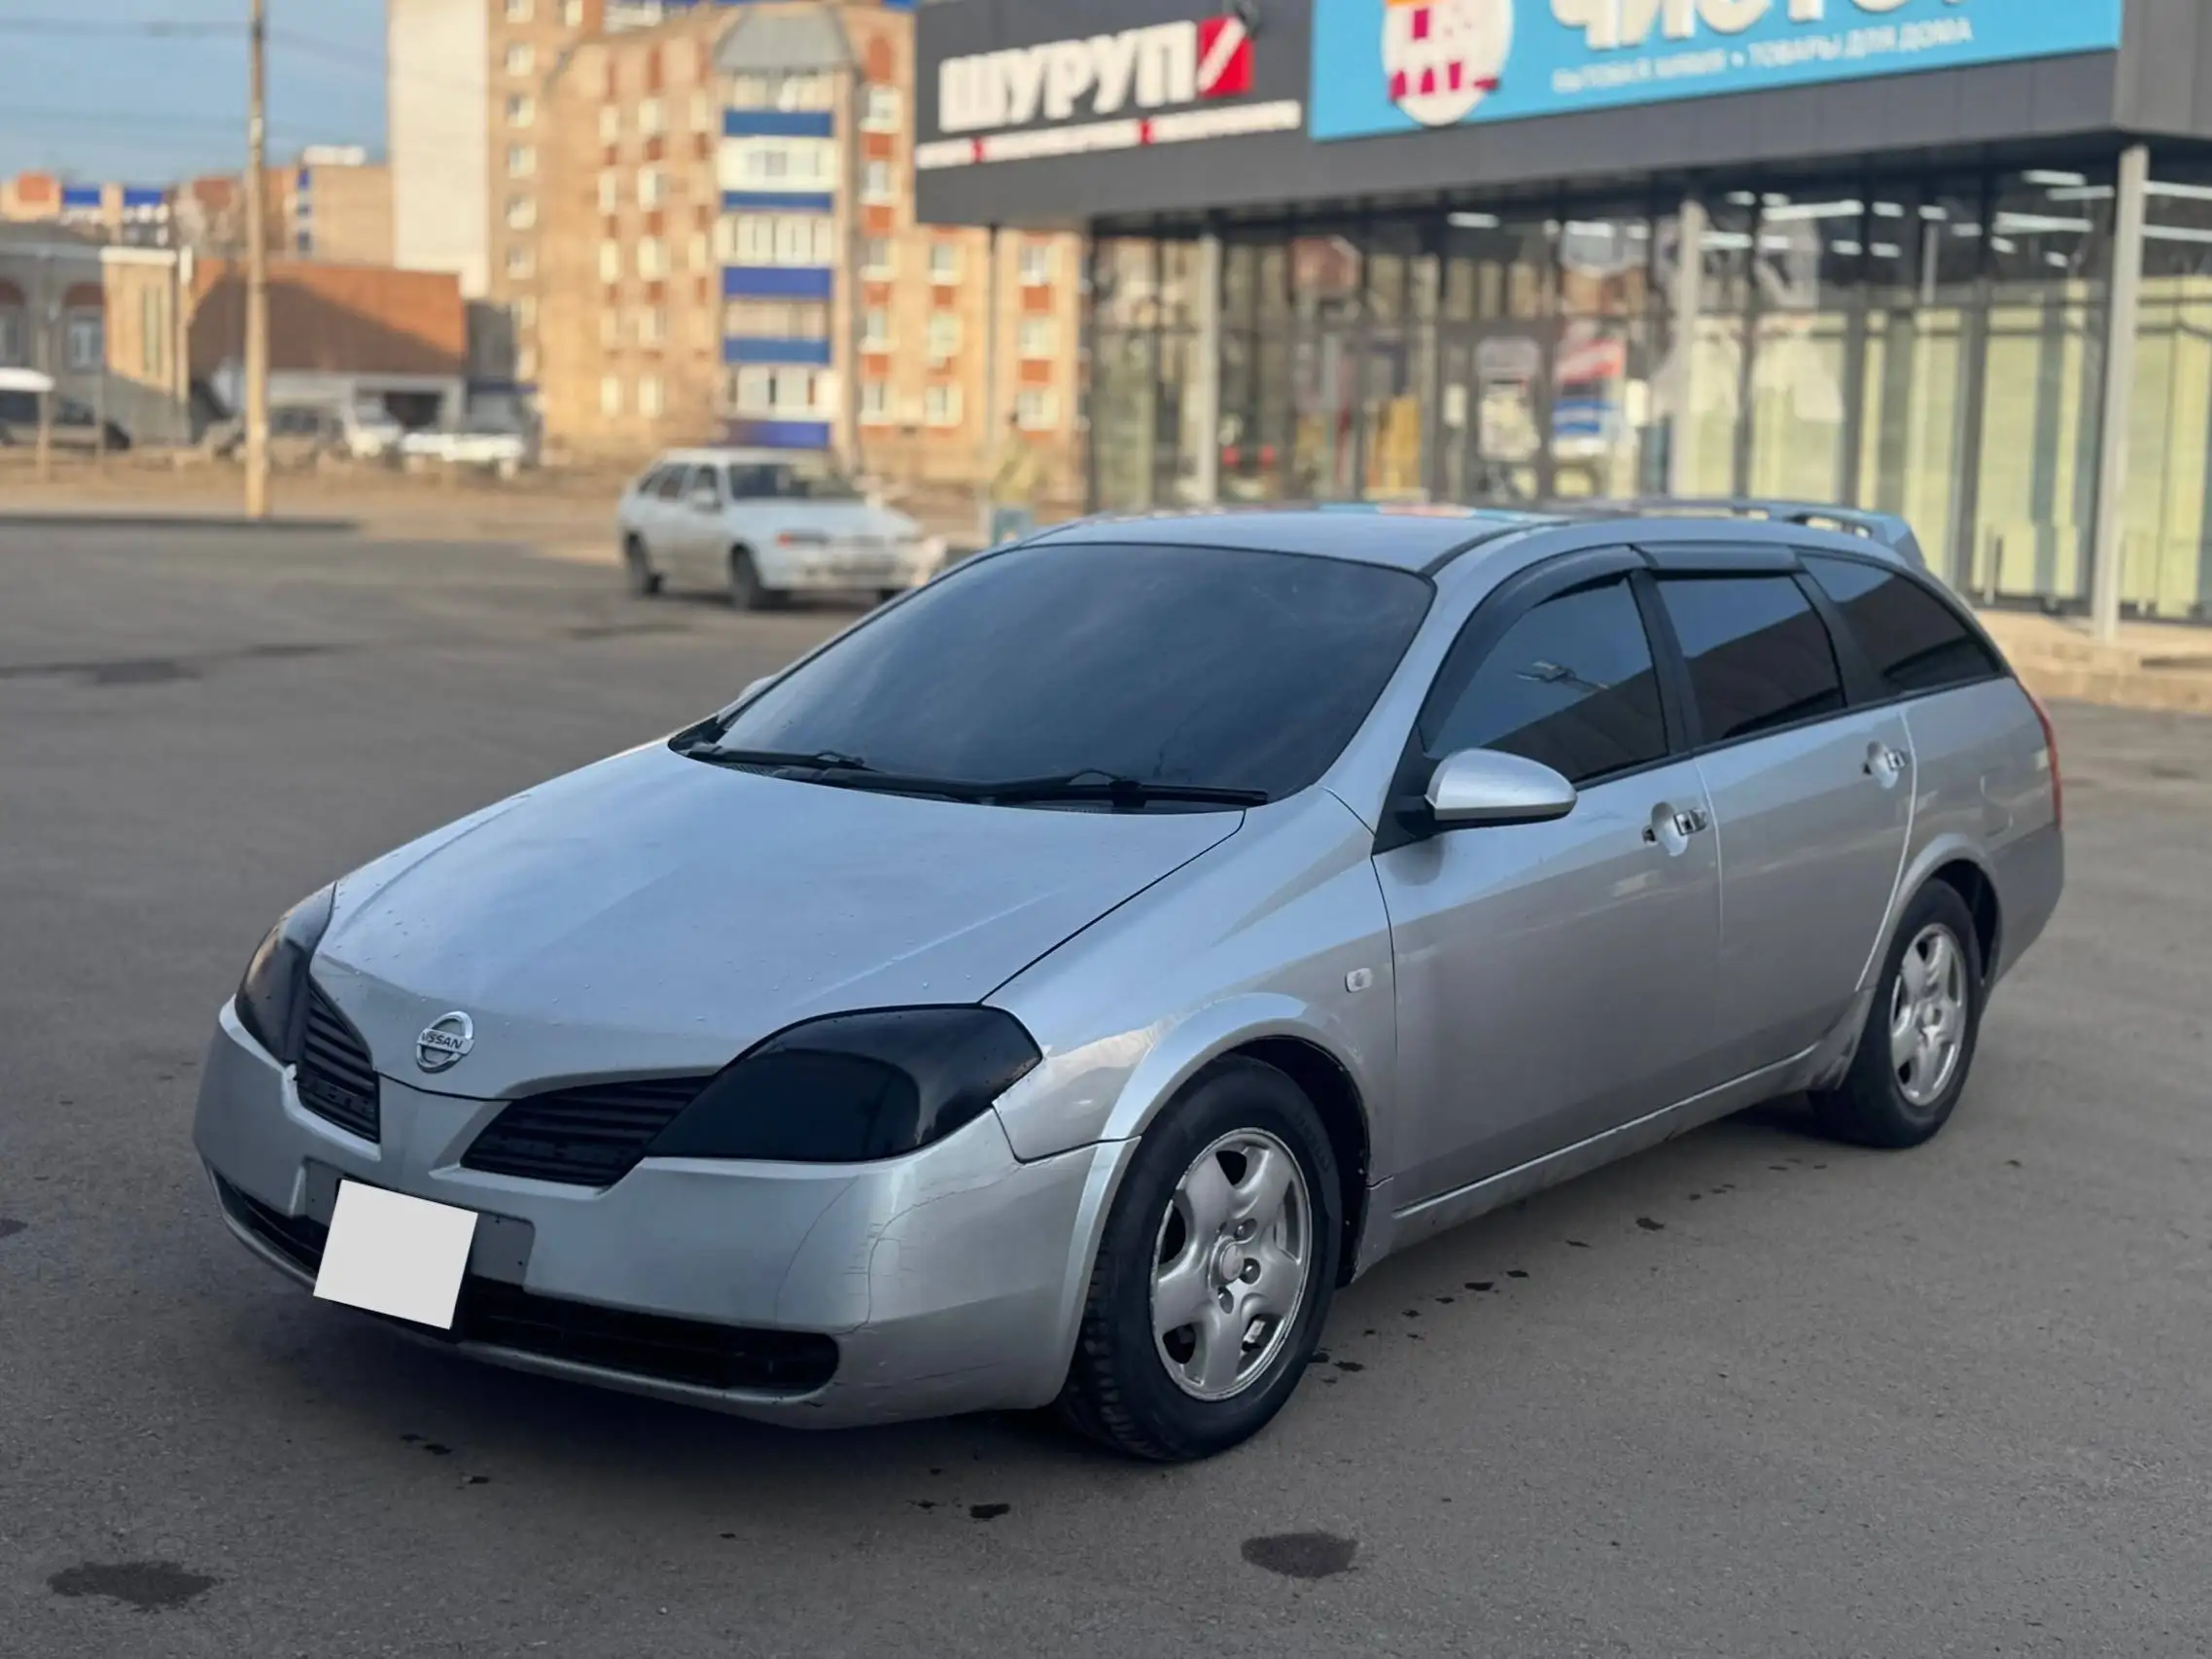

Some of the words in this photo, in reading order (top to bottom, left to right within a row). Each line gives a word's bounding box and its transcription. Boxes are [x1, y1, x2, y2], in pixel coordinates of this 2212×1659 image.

[1747, 33, 1843, 68] ТОВАРЫ
[1845, 25, 1896, 58] ДЛЯ
[1898, 16, 1975, 53] ДОМА
[937, 19, 1197, 133] ШУРУП
[421, 1031, 463, 1050] NISSAN
